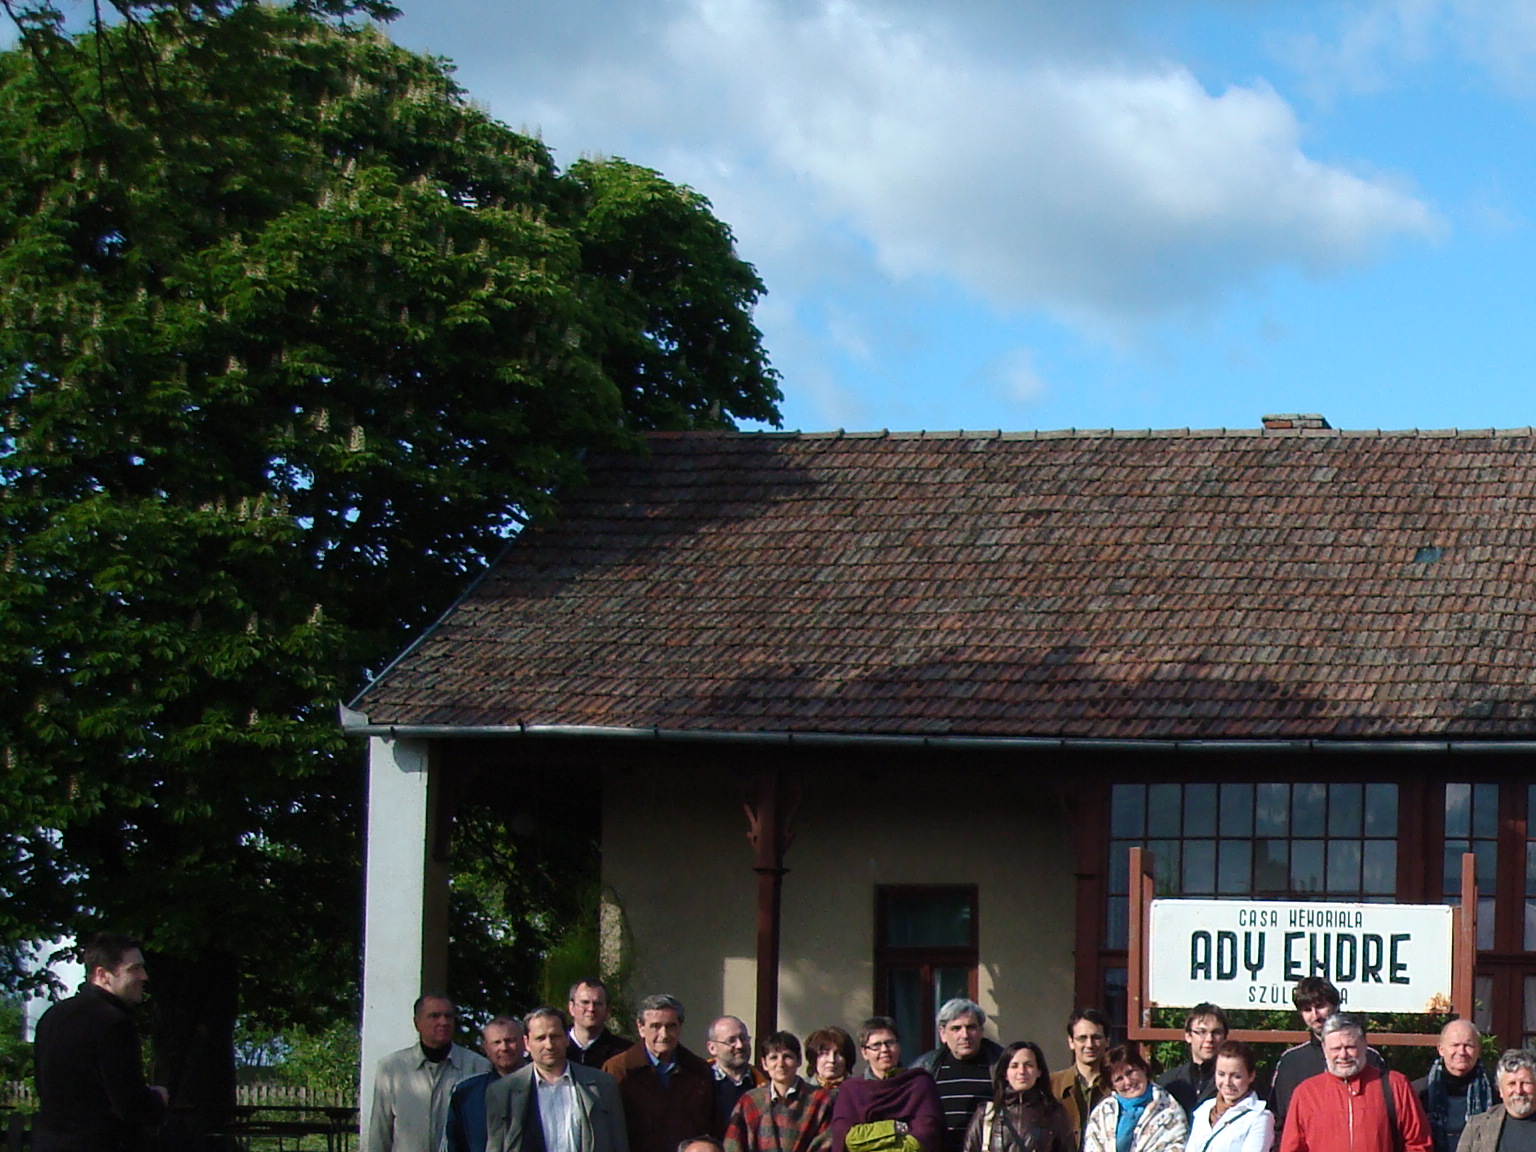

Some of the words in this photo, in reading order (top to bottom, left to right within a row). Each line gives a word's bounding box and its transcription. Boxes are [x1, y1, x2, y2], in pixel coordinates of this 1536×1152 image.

[1239, 909, 1278, 927] CASA
[1190, 930, 1266, 982] ADY
[1283, 931, 1411, 984] ENDRE
